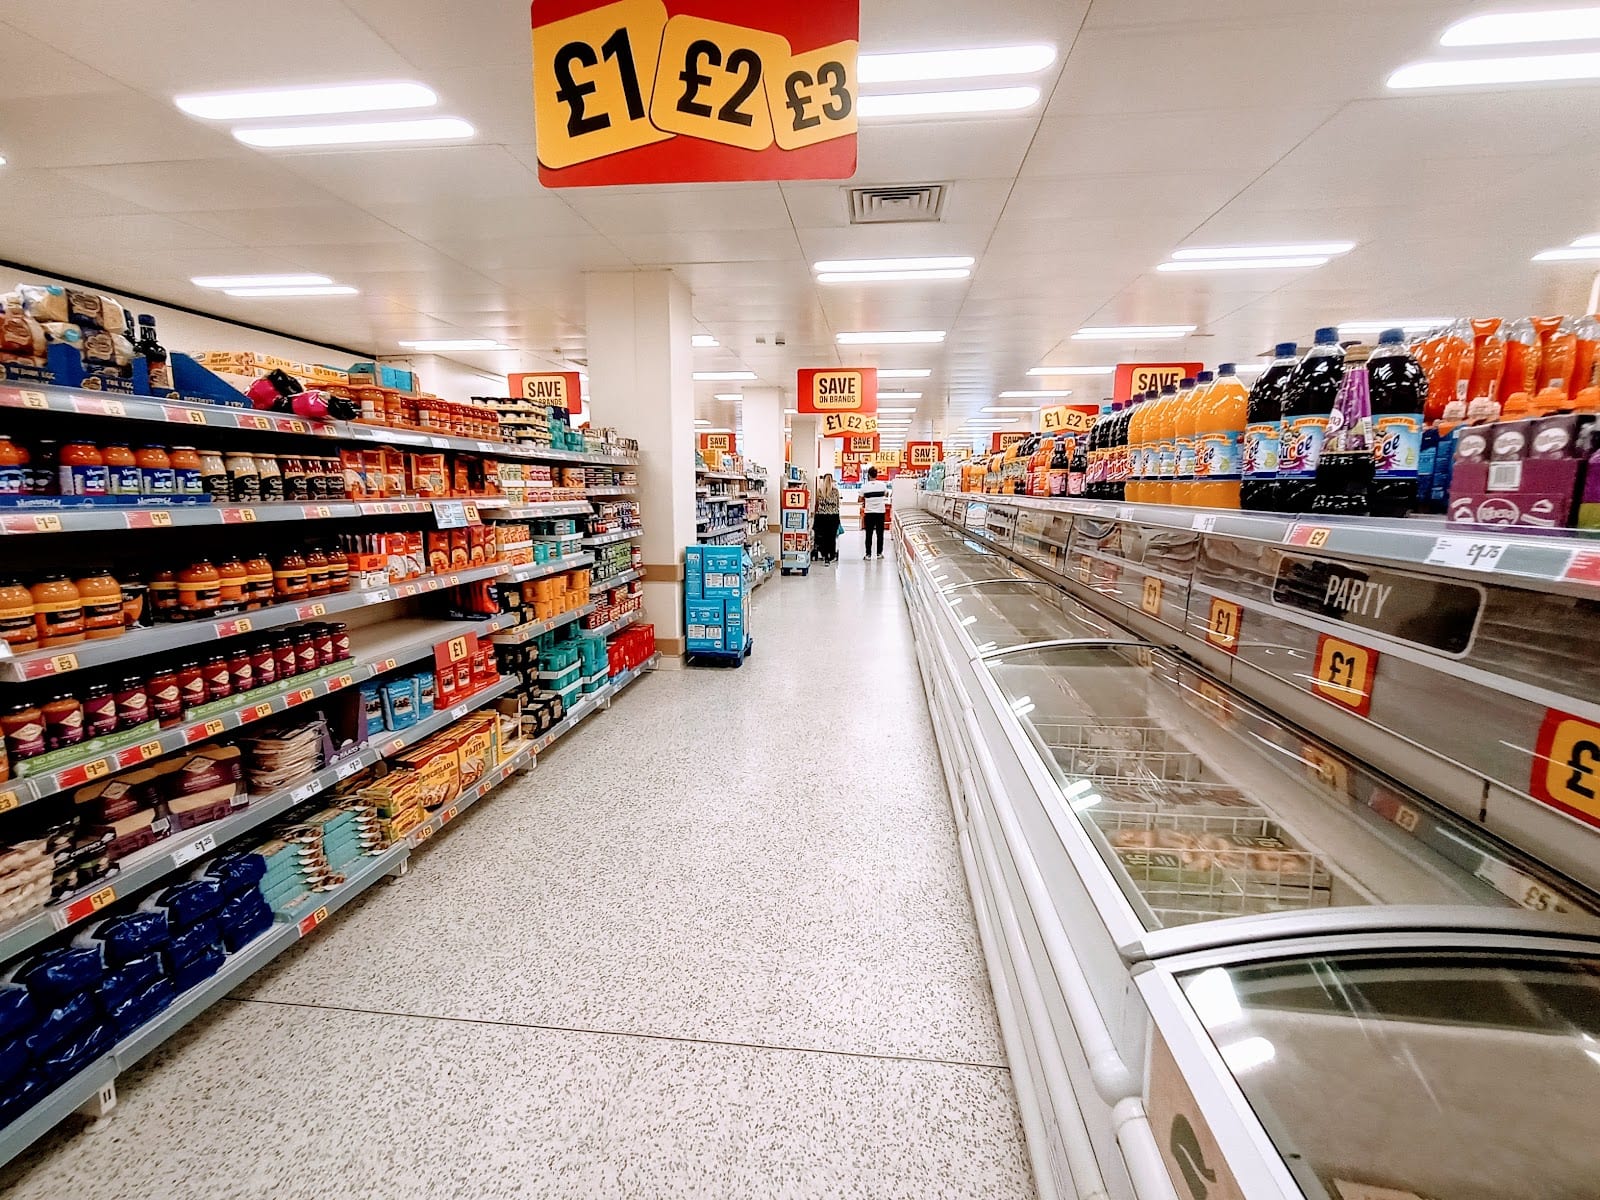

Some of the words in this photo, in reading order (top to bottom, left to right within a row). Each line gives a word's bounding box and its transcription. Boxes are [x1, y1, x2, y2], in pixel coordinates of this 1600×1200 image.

[555, 27, 645, 138] £1
[676, 39, 762, 127] £2
[785, 61, 852, 132] £3
[527, 381, 562, 397] SAVE
[819, 377, 856, 395] SAVE
[1138, 373, 1179, 391] SAVE
[819, 395, 828, 403] ON
[829, 395, 856, 403] BRANDS
[826, 413, 842, 430] £1
[847, 415, 862, 430] £2
[865, 419, 877, 430] £3
[1044, 411, 1061, 428] £1
[1066, 413, 1082, 428] £2
[709, 436, 727, 446] SAVE
[853, 437, 871, 446] SAVE
[876, 451, 896, 462] FREE
[790, 493, 801, 504] £1
[468, 506, 476, 518] £1
[1311, 531, 1326, 545] £2
[1466, 544, 1502, 566] £1.75
[1323, 574, 1393, 619] PARTY
[1214, 608, 1231, 634] £1
[453, 640, 464, 658] £1
[1328, 651, 1356, 690] £1
[464, 740, 486, 758] FAJITA
[421, 760, 455, 782] ENCHILADA
